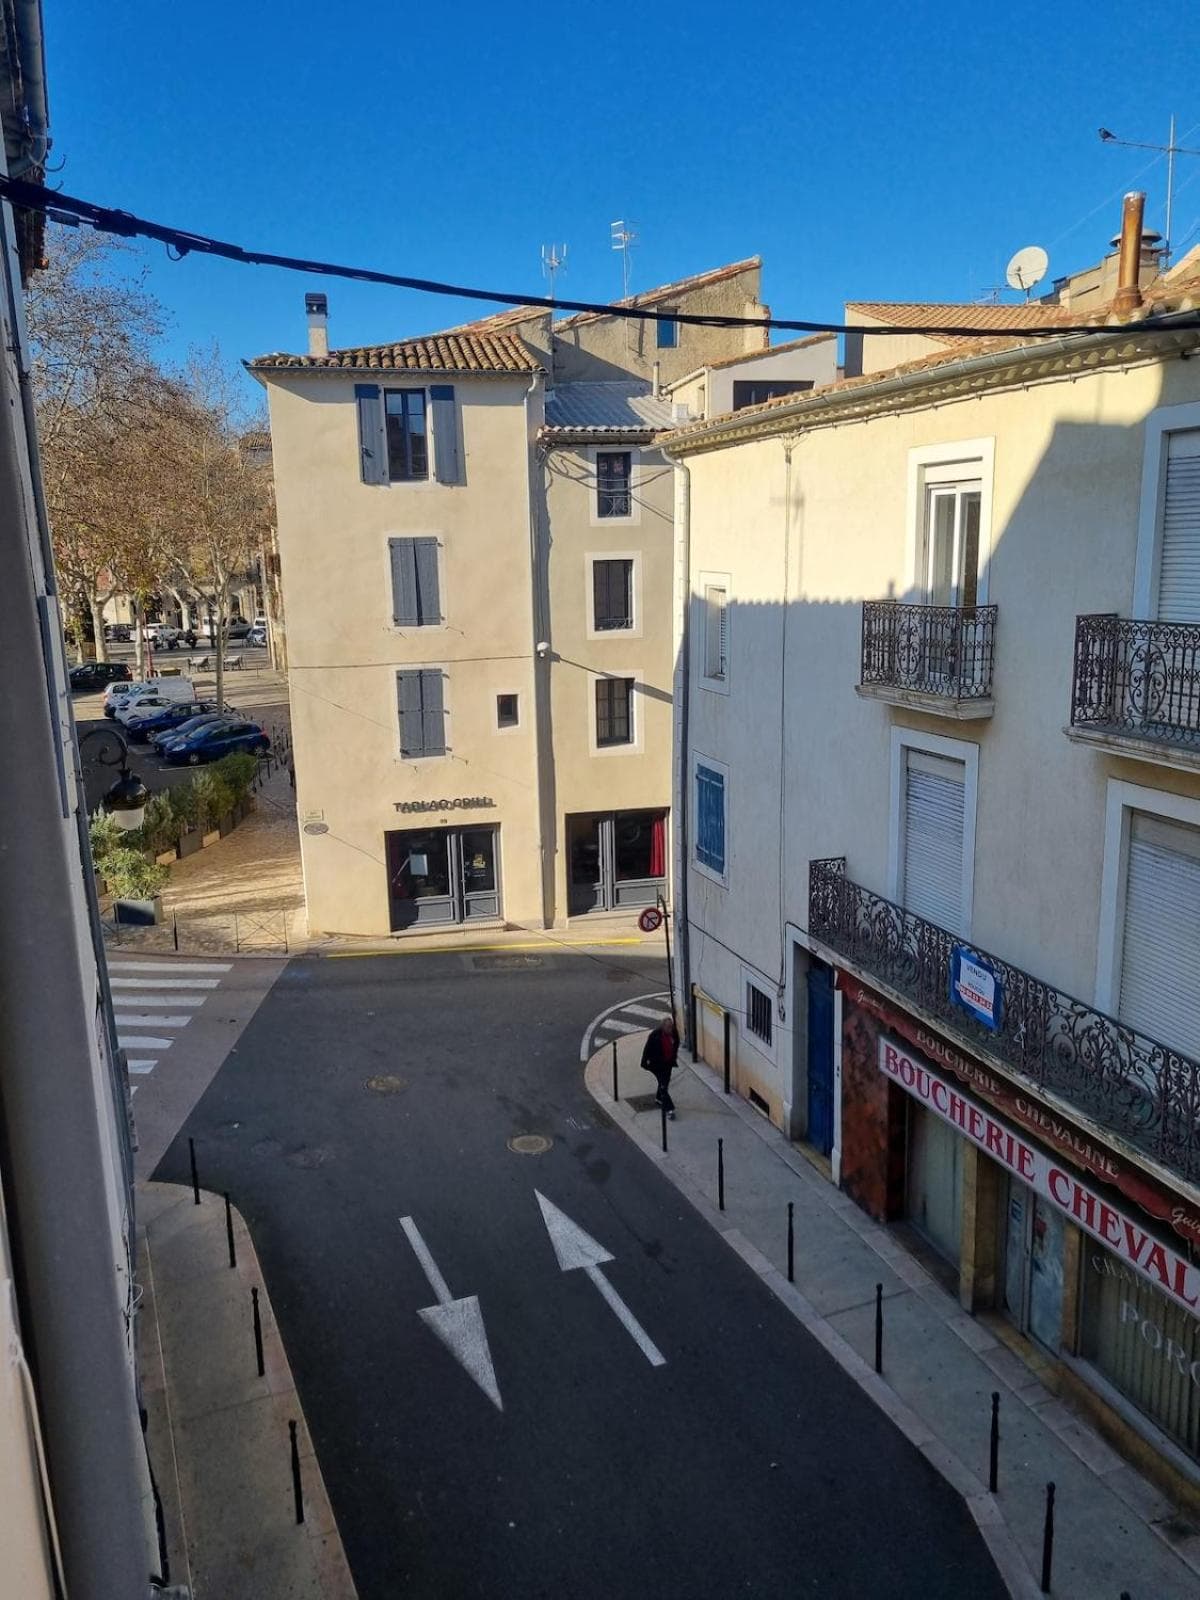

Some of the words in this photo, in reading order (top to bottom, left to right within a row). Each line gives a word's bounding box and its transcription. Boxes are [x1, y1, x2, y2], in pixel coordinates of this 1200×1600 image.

[884, 1043, 1036, 1182] BOUCHERIE
[1047, 1167, 1199, 1308] CHEVAL
[916, 1029, 1001, 1095] BOUCHERIE
[1015, 1097, 1119, 1179] CHEVALINE
